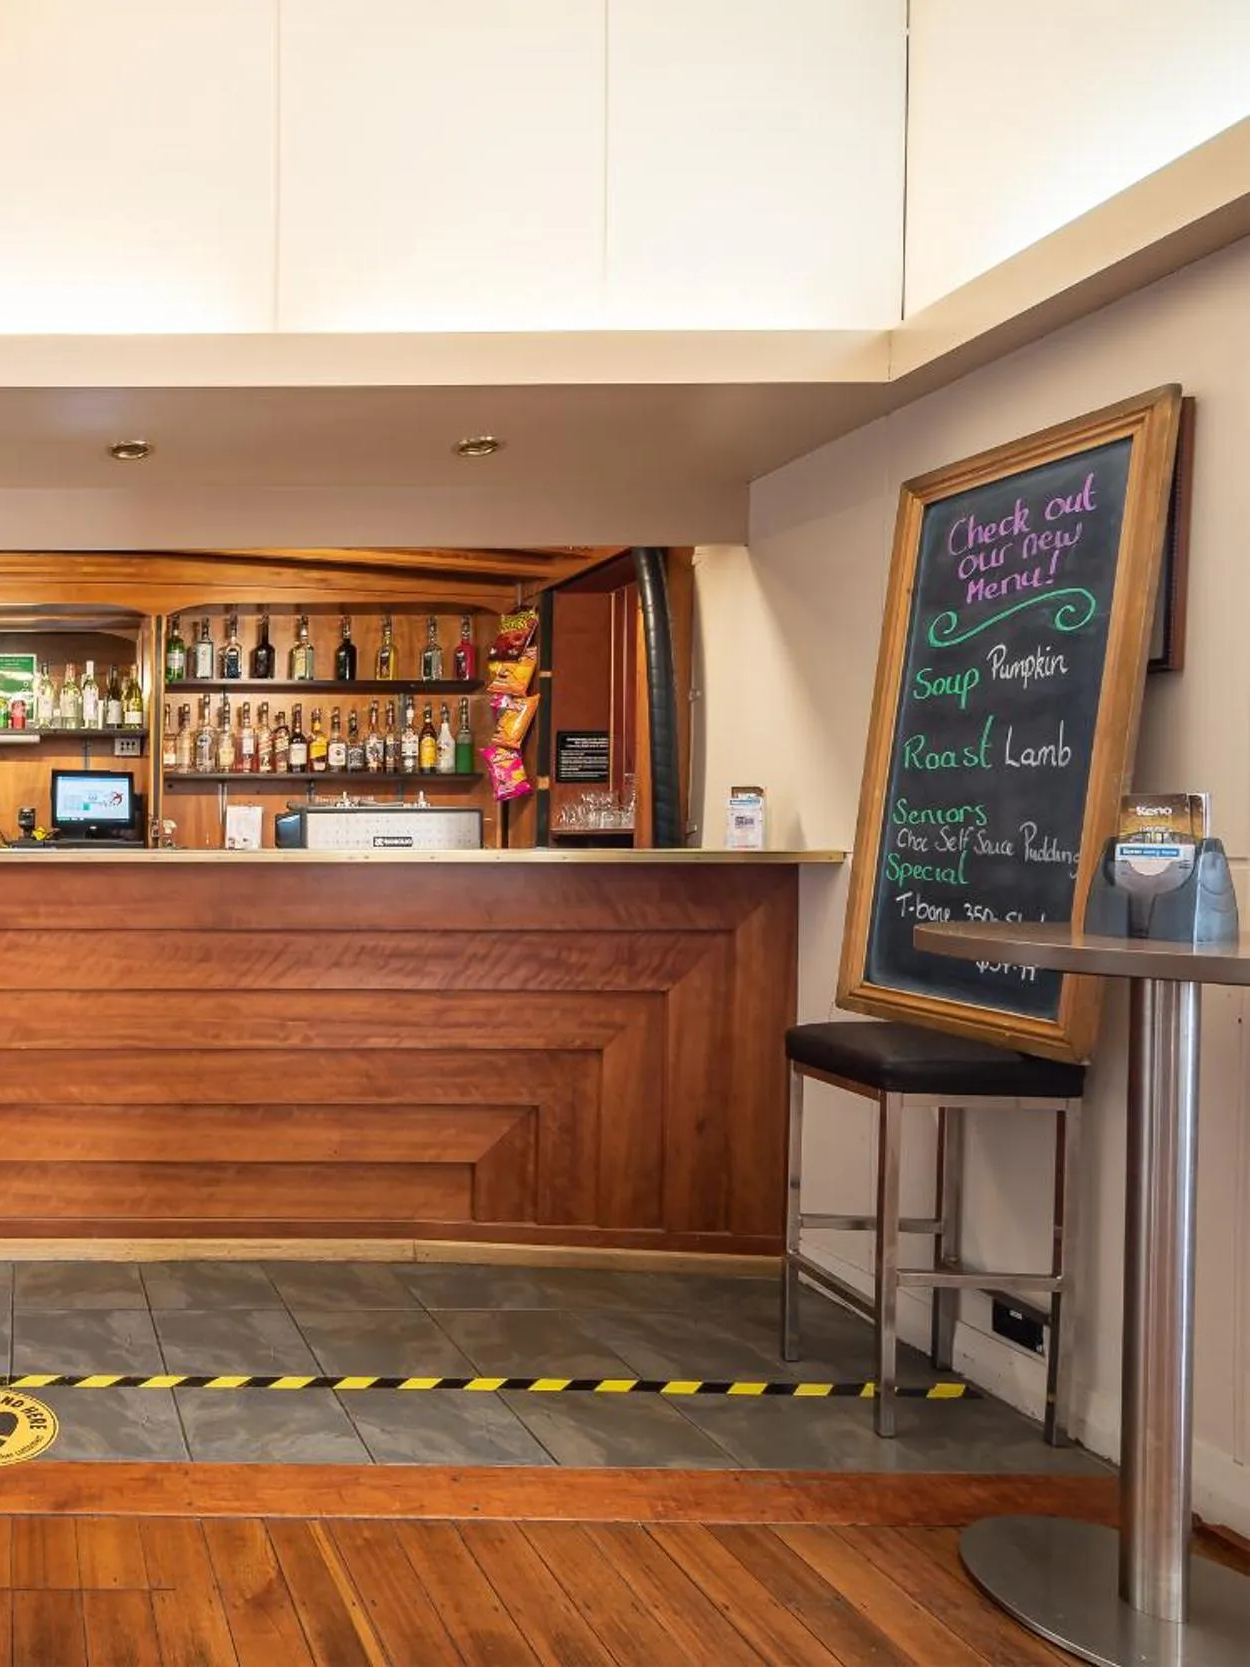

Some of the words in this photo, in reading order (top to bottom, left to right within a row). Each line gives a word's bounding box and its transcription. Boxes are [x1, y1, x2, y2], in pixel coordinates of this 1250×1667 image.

[949, 499, 1030, 556] Check
[1045, 472, 1097, 520] out
[958, 544, 1013, 580] our
[1023, 523, 1082, 559] new
[966, 551, 1061, 603] Menu!
[913, 667, 979, 709] Soup
[987, 644, 1069, 689] Pumpkin
[904, 715, 993, 771] Roast
[1005, 720, 1072, 767] Lamb
[893, 799, 988, 826] Seniors
[886, 851, 969, 887] Special
[897, 828, 927, 852] Choc
[935, 826, 974, 852] Self
[974, 829, 1014, 856] Sauce
[1019, 821, 1081, 879] Pudding
[21, 1405, 47, 1430] HERE
